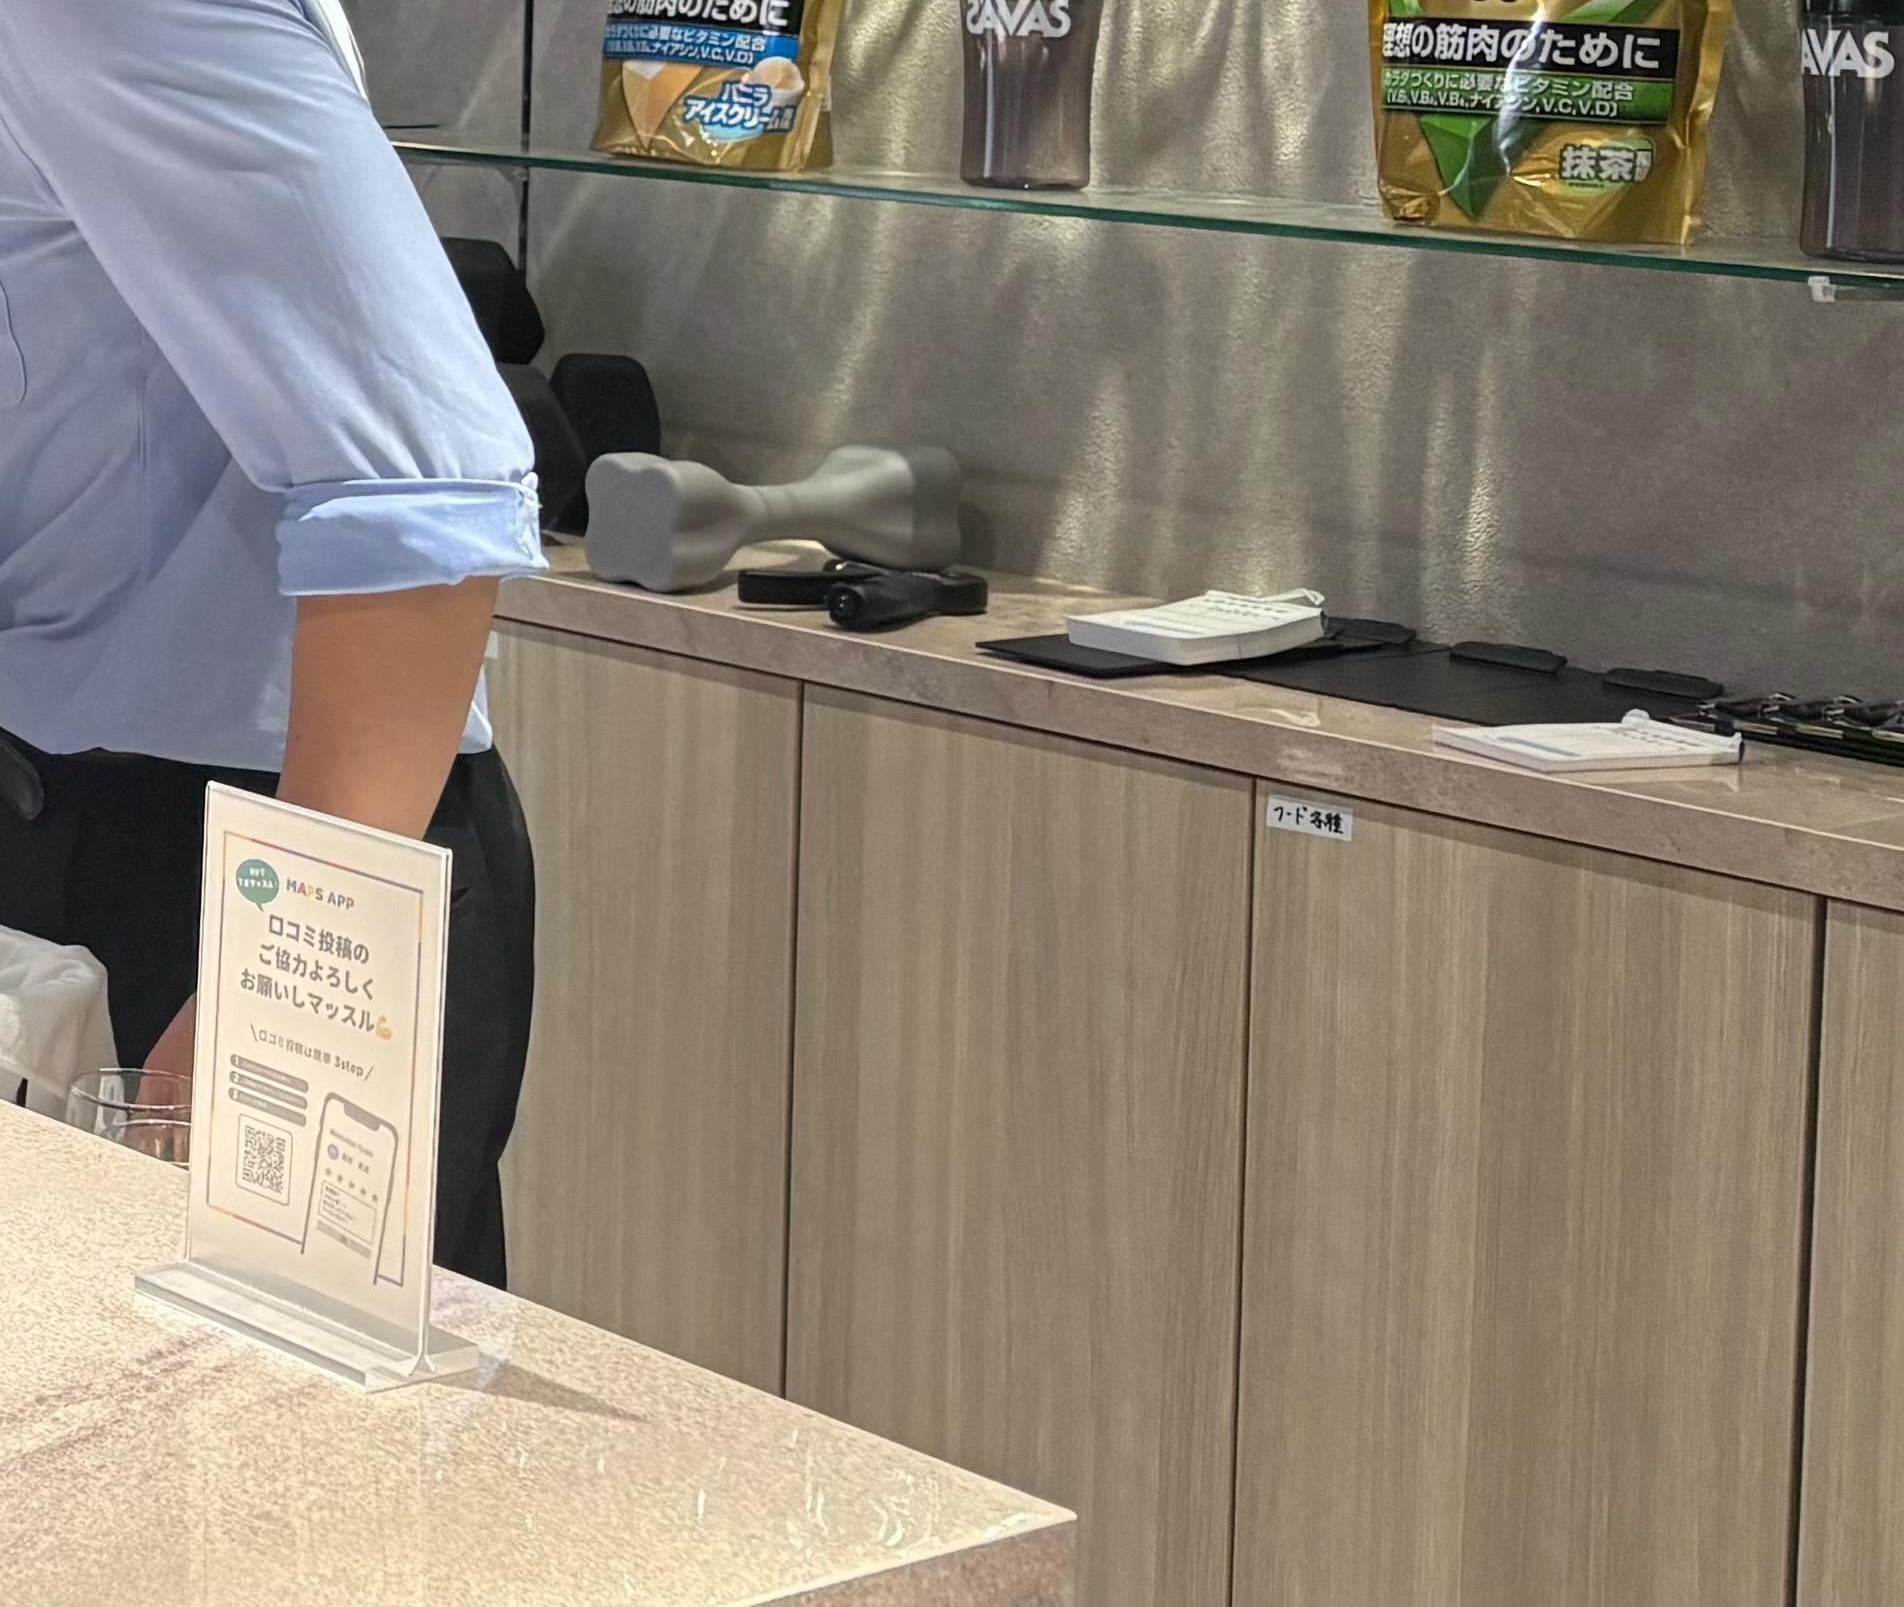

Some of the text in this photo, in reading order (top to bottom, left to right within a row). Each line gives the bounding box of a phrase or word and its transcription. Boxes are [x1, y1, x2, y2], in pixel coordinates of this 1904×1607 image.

[1800, 28, 1895, 79] AVAS
[722, 82, 769, 105] バニラ
[286, 877, 355, 910] MAPS APP
[268, 914, 370, 965] 口コミ投稿の
[259, 943, 374, 1001] ご協力よろしく
[240, 967, 375, 1033] お願いしマッスル
